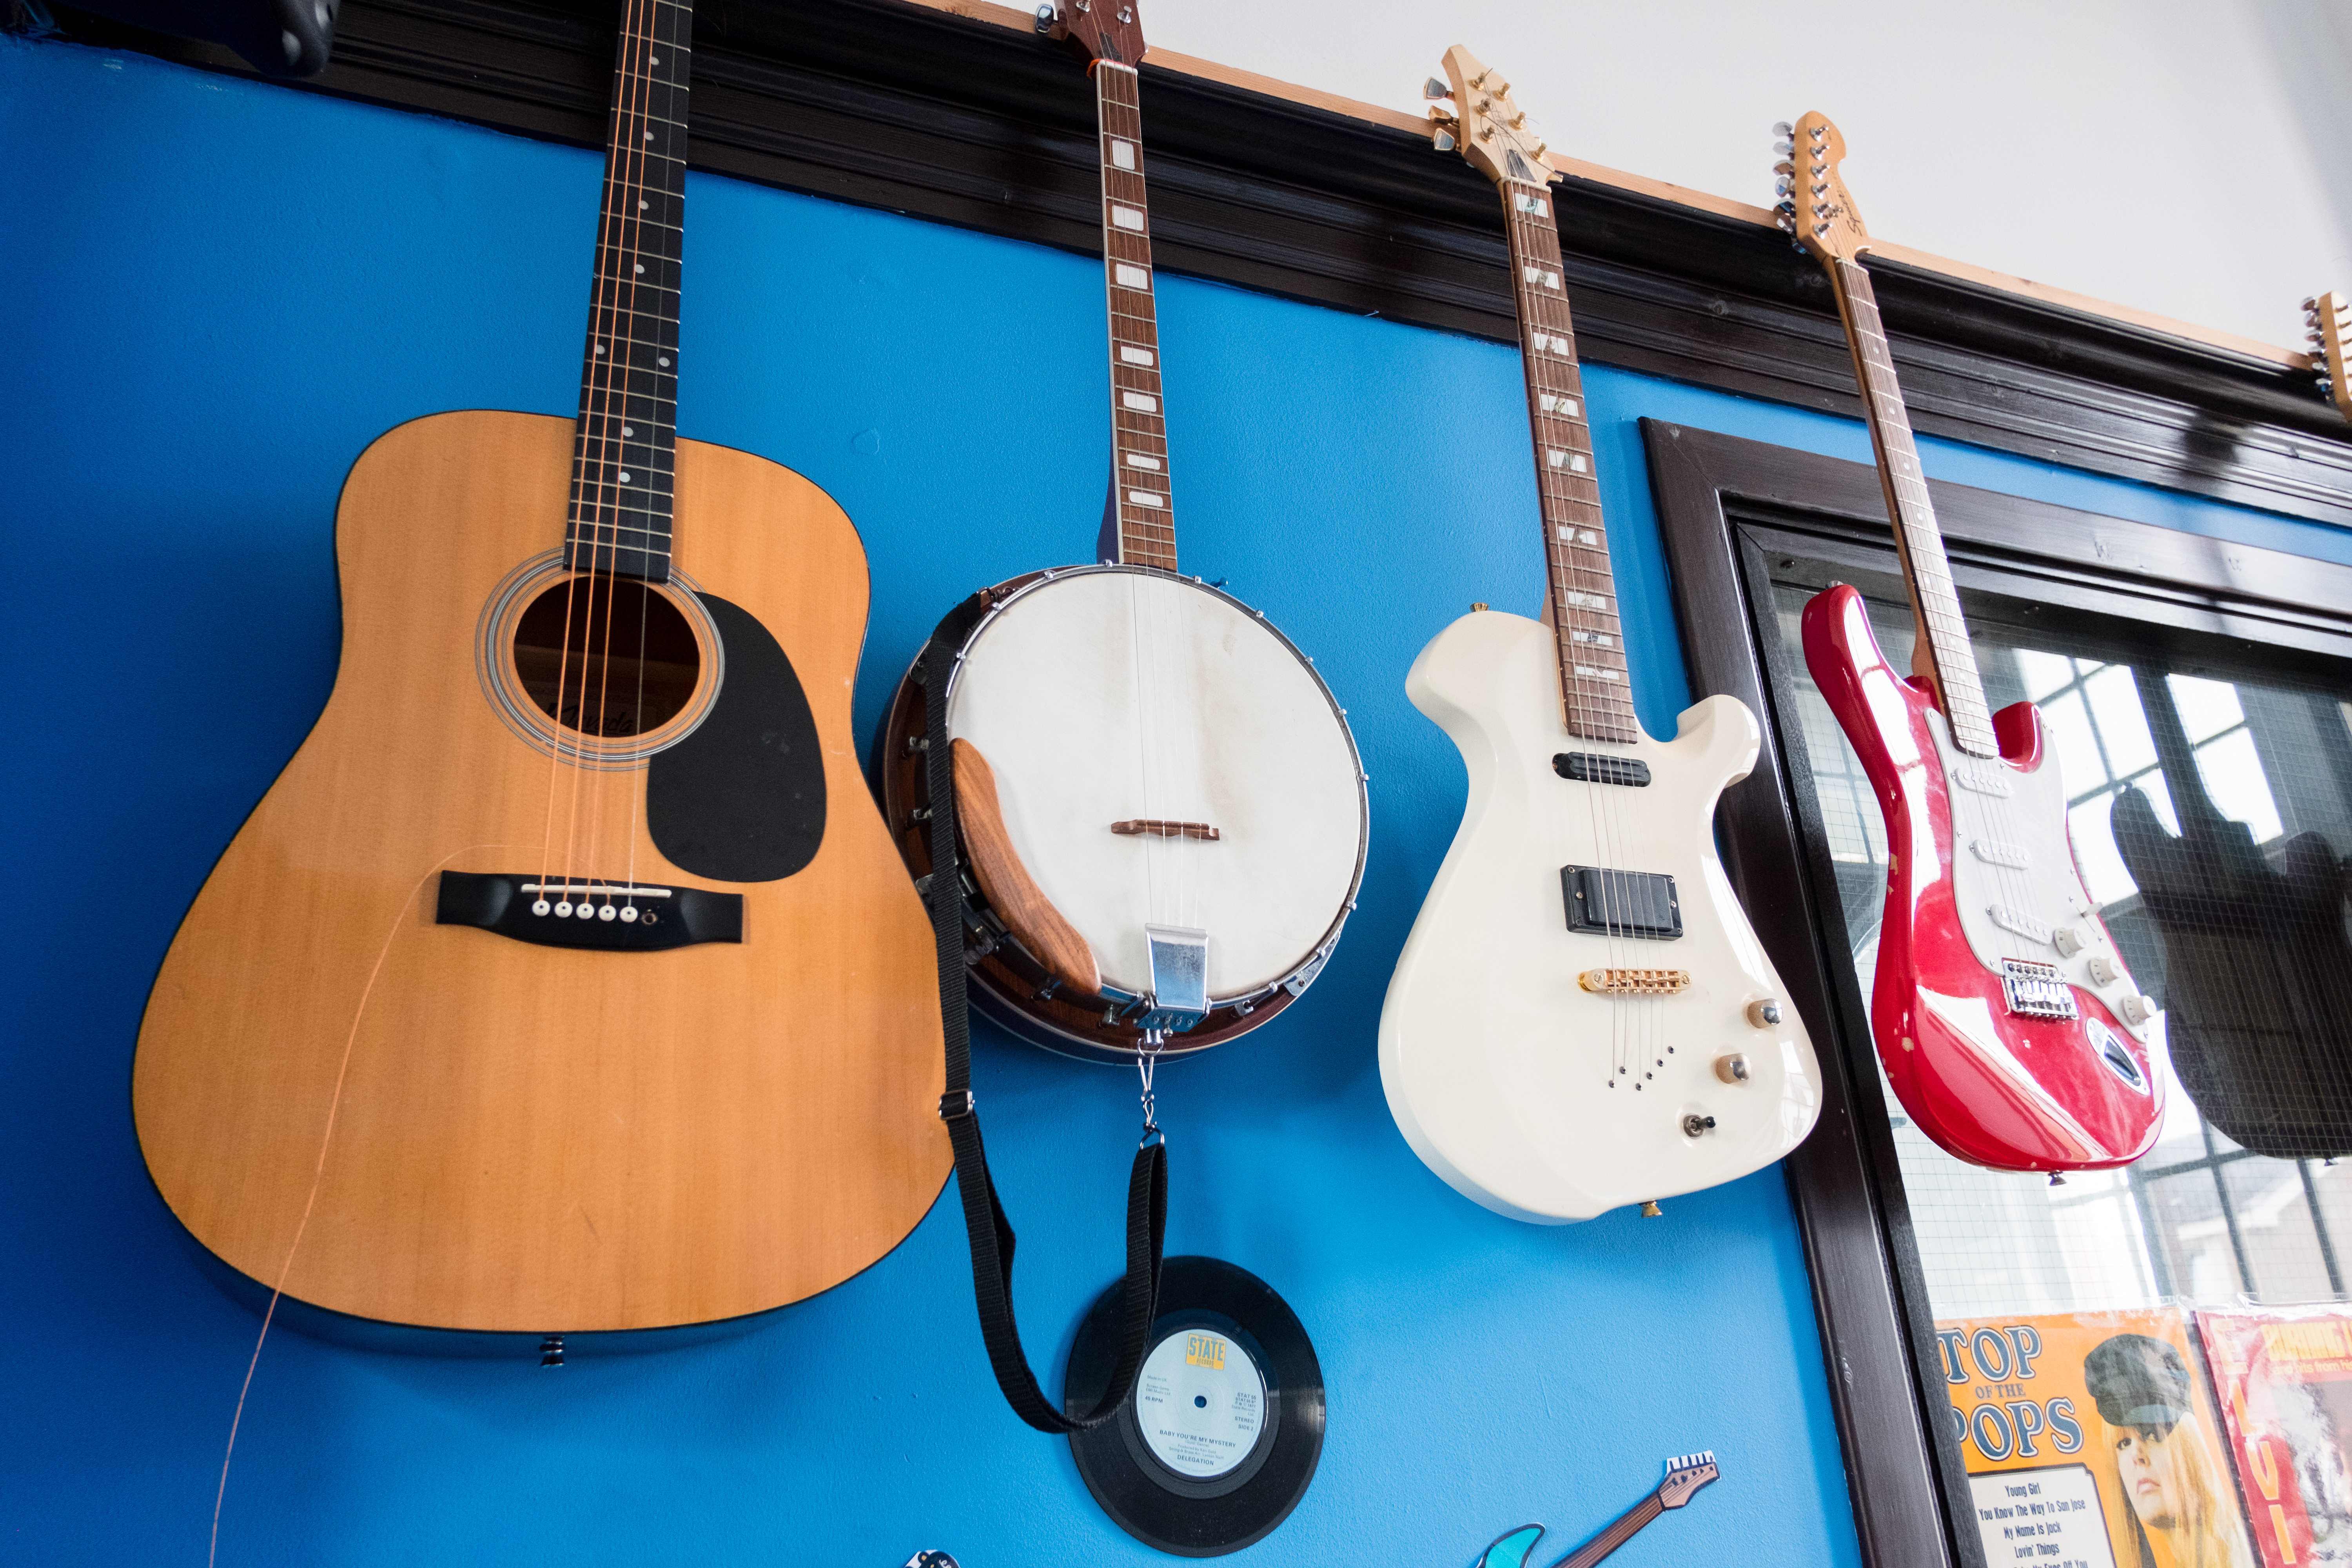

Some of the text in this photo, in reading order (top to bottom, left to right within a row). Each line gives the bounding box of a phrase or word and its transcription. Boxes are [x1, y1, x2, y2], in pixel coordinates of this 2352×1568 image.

[1189, 1337, 1225, 1361] STATE
[2260, 1321, 2346, 1361] BURNING
[1196, 1358, 1214, 1366] RECORDS
[1936, 1325, 2042, 1384] TOP
[2314, 1361, 2340, 1372] from
[1975, 1383, 2026, 1400] OF THE
[1177, 1432, 1198, 1441] YOU'RE
[1209, 1439, 1236, 1448] MYSTERY
[1177, 1455, 1214, 1466] DELEGATION
[2004, 1483, 2041, 1497] Young Girl
[1978, 1499, 2086, 1521] You Know The Way To San Jose
[2004, 1521, 2062, 1540] My Name Is Jack
[2014, 1543, 2060, 1559] Lovin' Things
